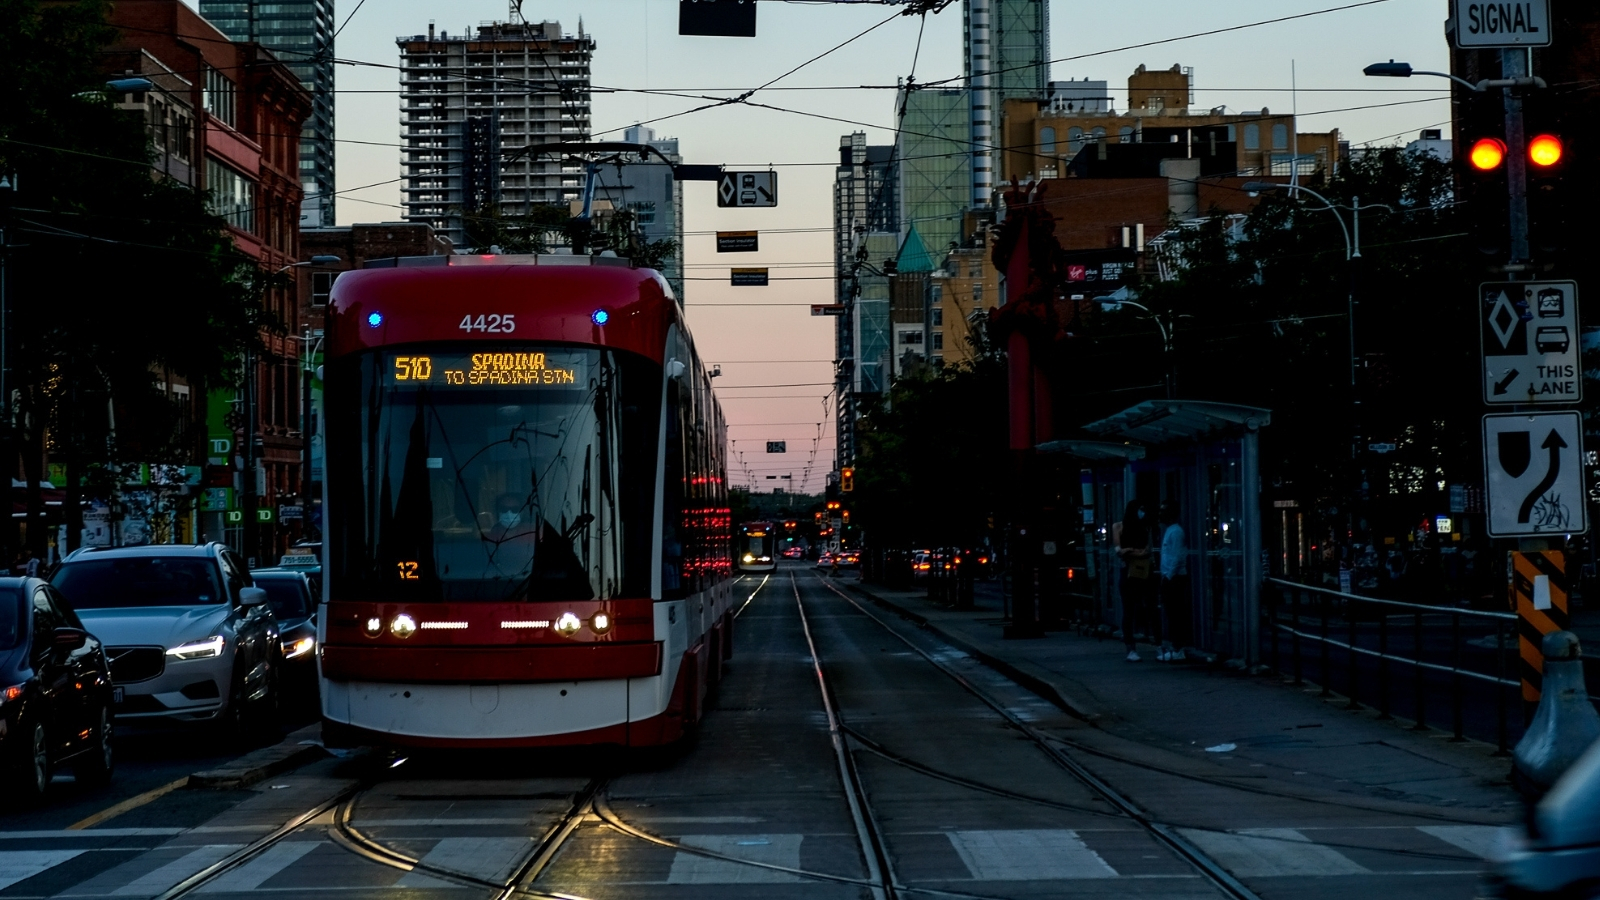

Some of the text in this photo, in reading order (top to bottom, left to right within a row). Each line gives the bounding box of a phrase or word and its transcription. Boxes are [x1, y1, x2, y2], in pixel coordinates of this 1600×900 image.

[1469, 3, 1539, 34] SIGNAL
[459, 314, 515, 333] 4425
[394, 352, 546, 381] 510 SPADINA
[1536, 365, 1574, 378] THIS
[444, 369, 575, 385] TO SPADINA STN
[1529, 381, 1574, 394] LANE
[210, 439, 231, 453] TD
[227, 511, 242, 521] TD
[257, 510, 271, 520] TD
[397, 560, 419, 580] 12
